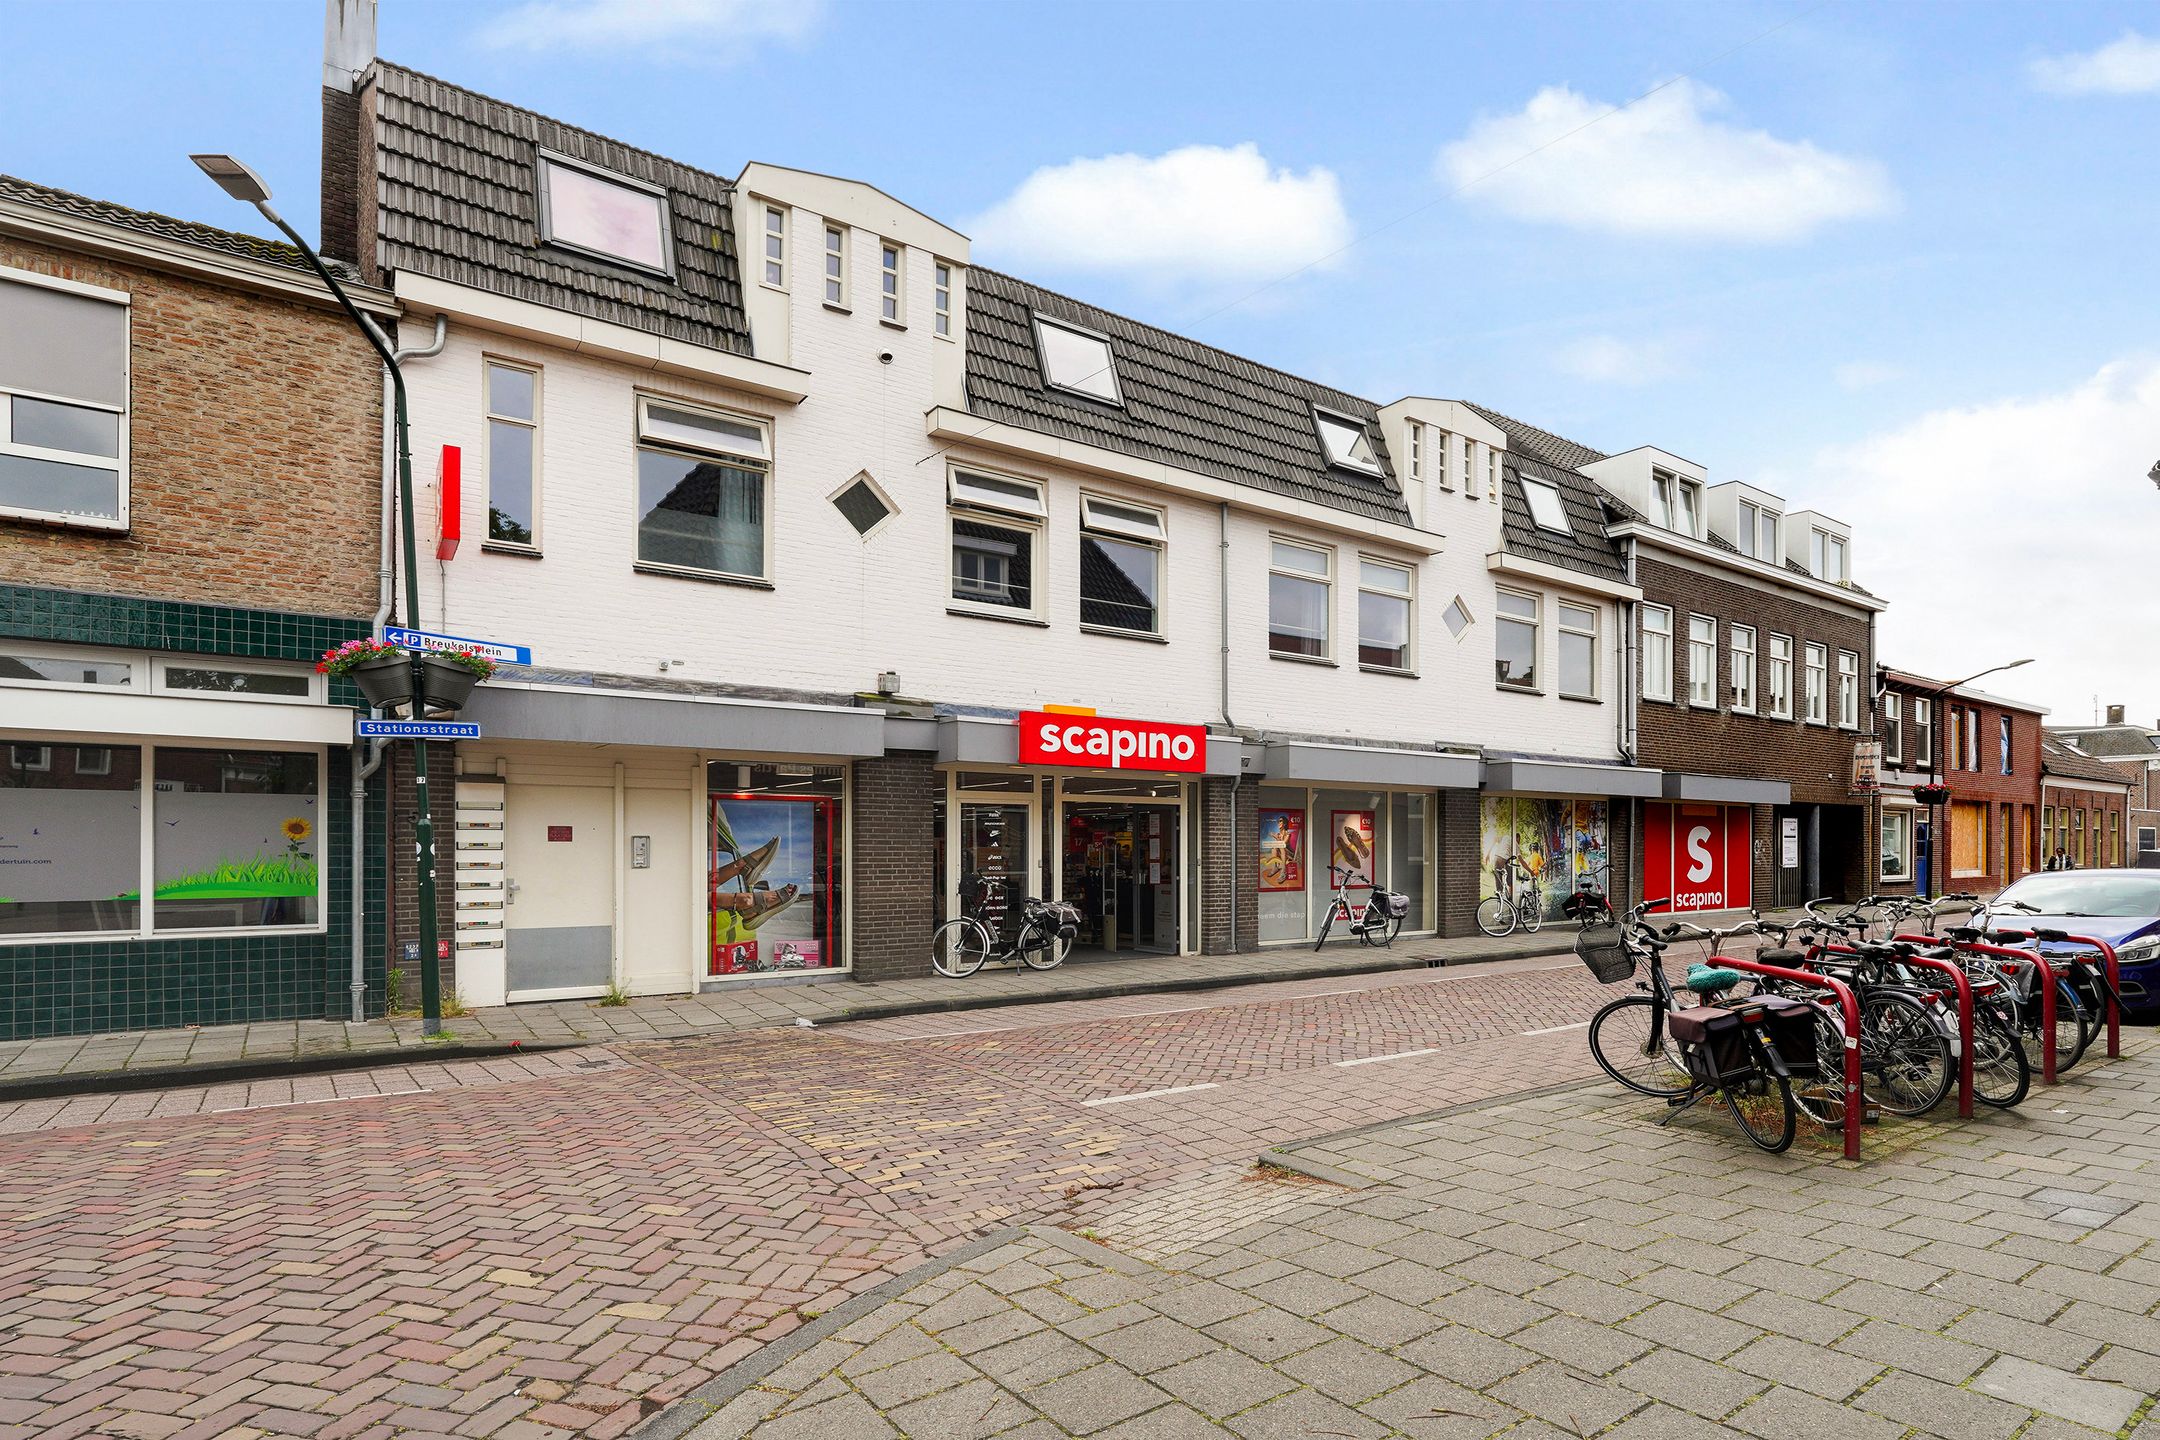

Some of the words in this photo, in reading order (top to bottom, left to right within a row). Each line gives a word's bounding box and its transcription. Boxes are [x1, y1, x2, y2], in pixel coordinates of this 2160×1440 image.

[367, 724, 473, 734] Stationsstraat
[1039, 724, 1196, 768] scapino
[1687, 826, 1712, 883] S
[1676, 891, 1722, 911] scapino
